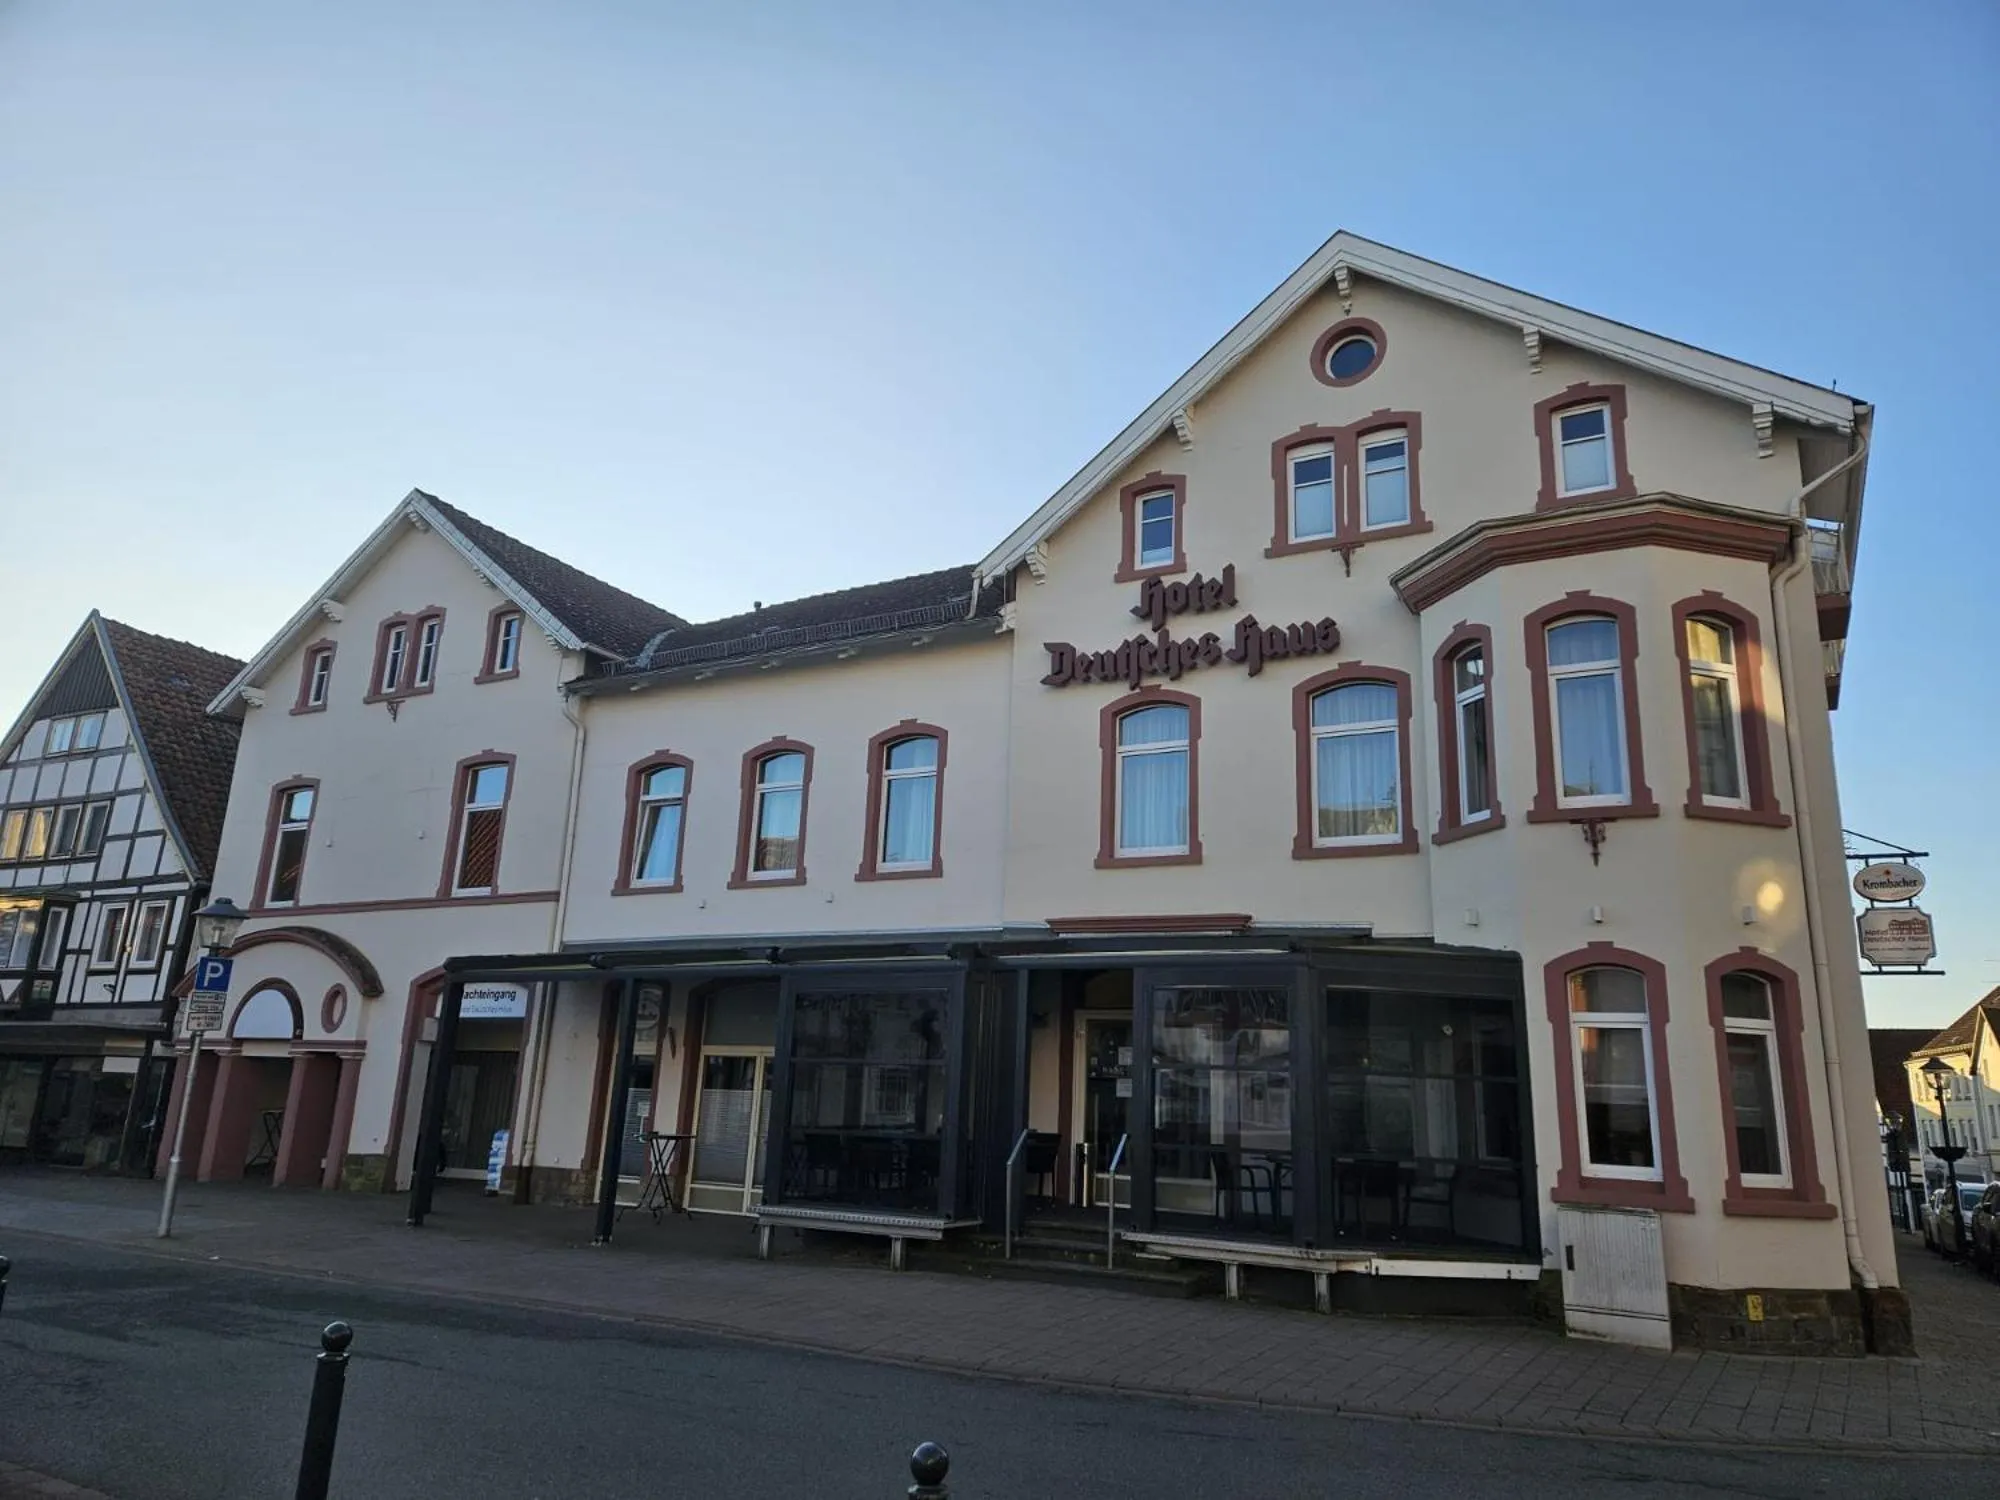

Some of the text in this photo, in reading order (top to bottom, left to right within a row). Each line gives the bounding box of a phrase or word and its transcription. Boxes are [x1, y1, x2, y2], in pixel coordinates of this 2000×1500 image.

[1129, 563, 1239, 632] Hotel
[1224, 613, 1342, 678] Haus
[1862, 878, 1918, 890] Krombacher
[203, 962, 225, 987] P
[463, 988, 517, 1002] achteingang
